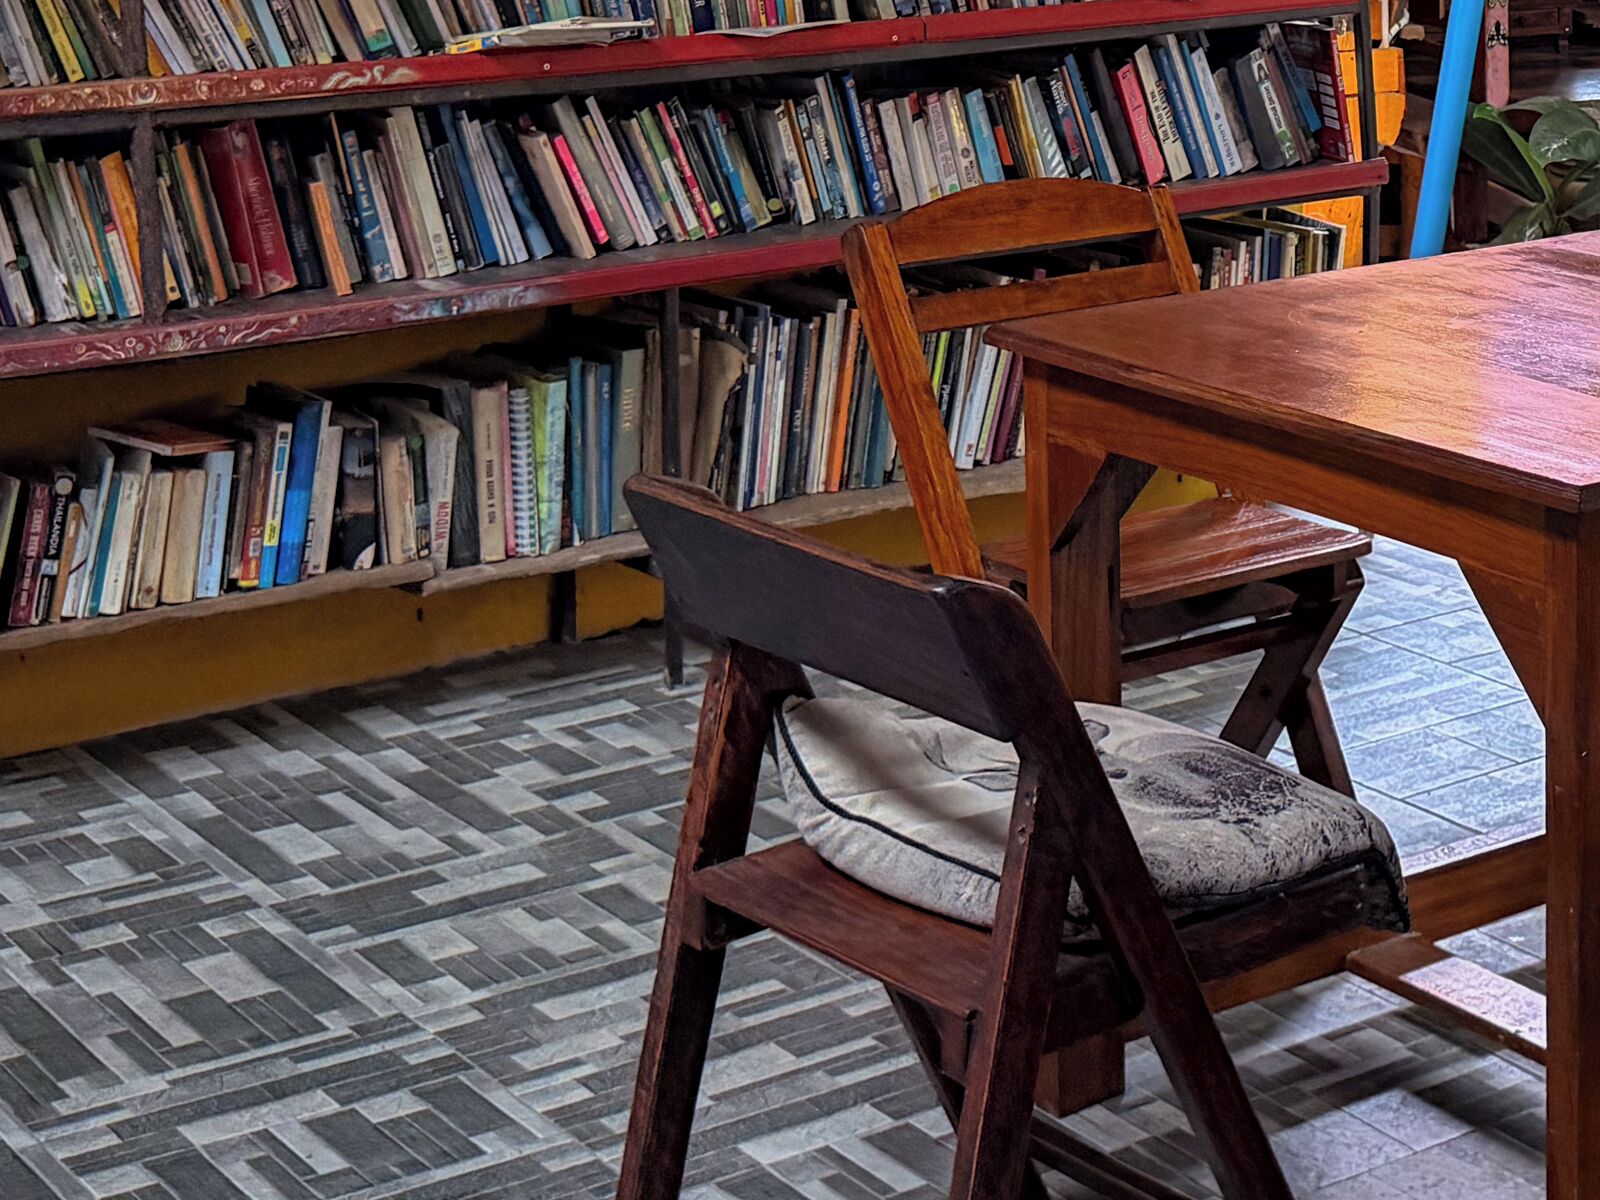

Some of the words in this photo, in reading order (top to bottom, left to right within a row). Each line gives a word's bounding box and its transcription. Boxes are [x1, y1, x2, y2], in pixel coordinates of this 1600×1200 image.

[1049, 79, 1064, 114] Harris
[1055, 80, 1068, 107] Robert
[46, 495, 66, 556] THAILANDIA
[434, 500, 449, 541] WIDOW
